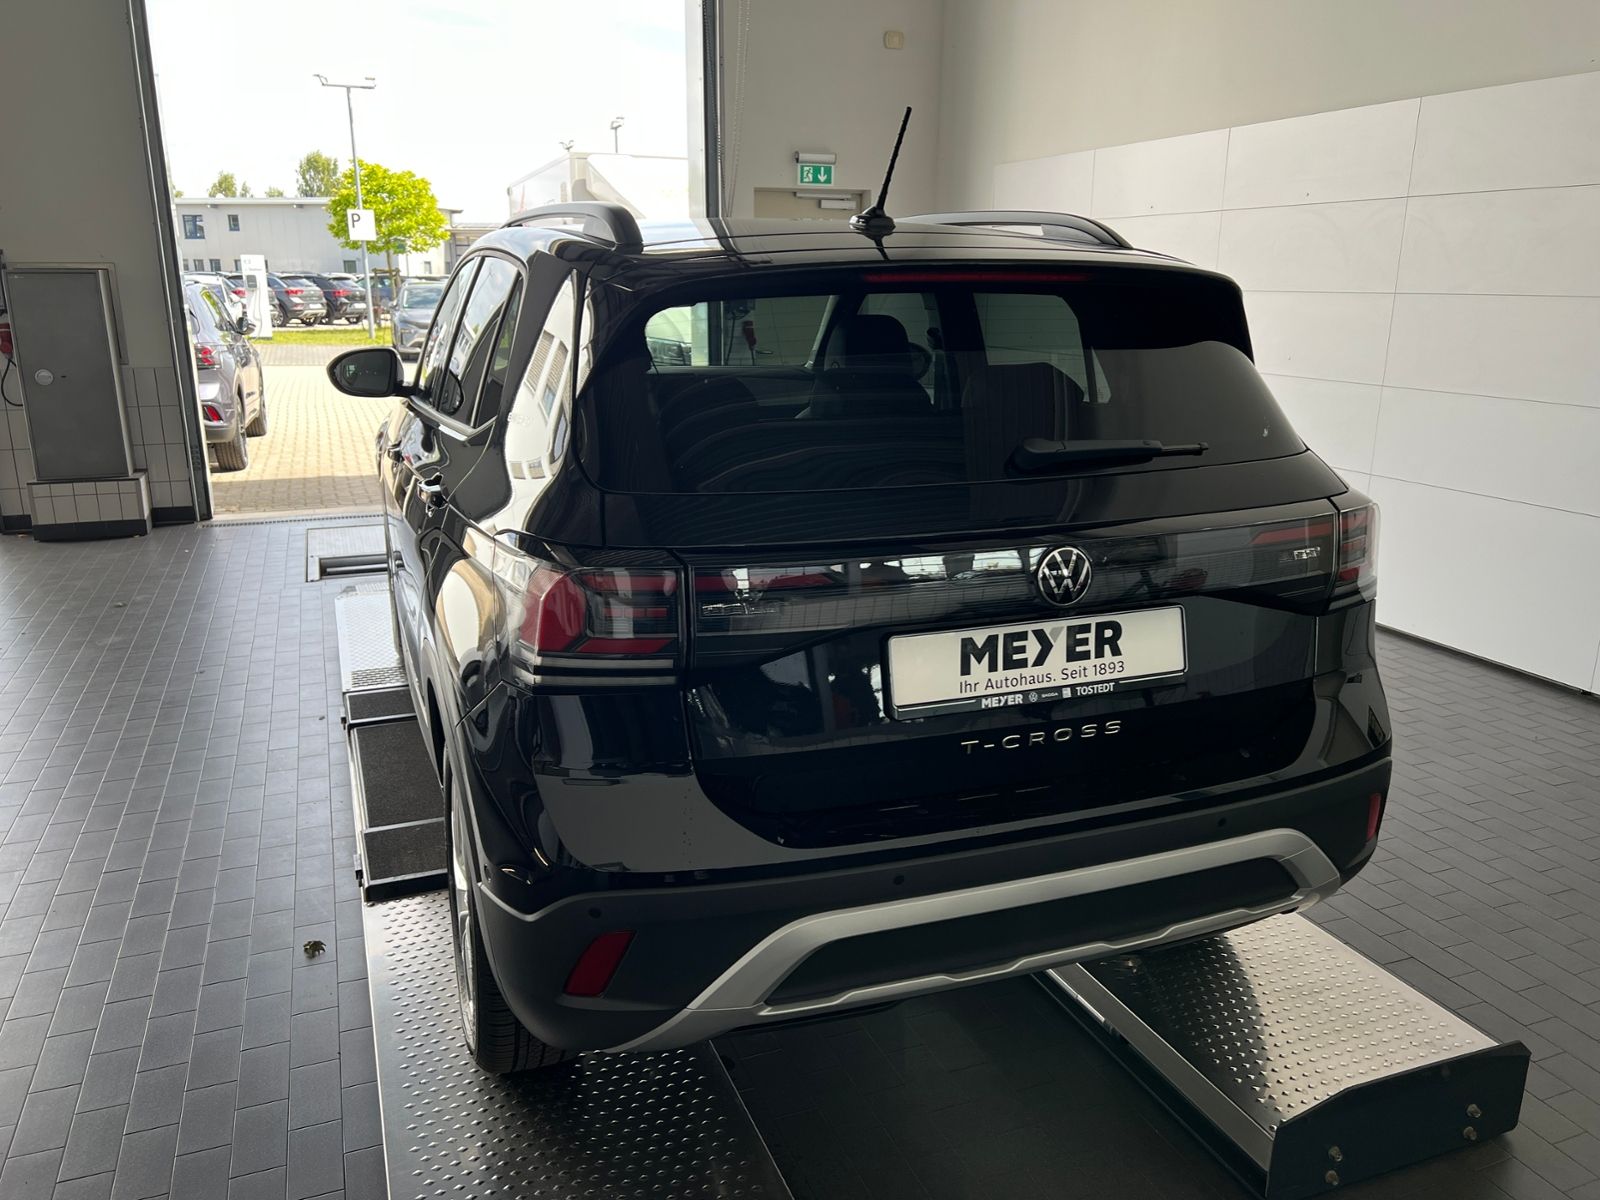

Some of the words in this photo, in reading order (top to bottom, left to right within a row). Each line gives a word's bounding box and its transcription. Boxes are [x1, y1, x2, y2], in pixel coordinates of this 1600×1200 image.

[351, 213, 361, 228] P
[959, 620, 1123, 676] MEYER
[959, 681, 980, 694] Ihr
[984, 673, 1057, 691] Autohaus.
[1061, 666, 1088, 681] Seit
[1092, 660, 1126, 676] 1893
[981, 694, 1024, 709] MEYER
[1075, 682, 1116, 696] TOSTEDT
[960, 720, 1122, 755] T-CROSS
